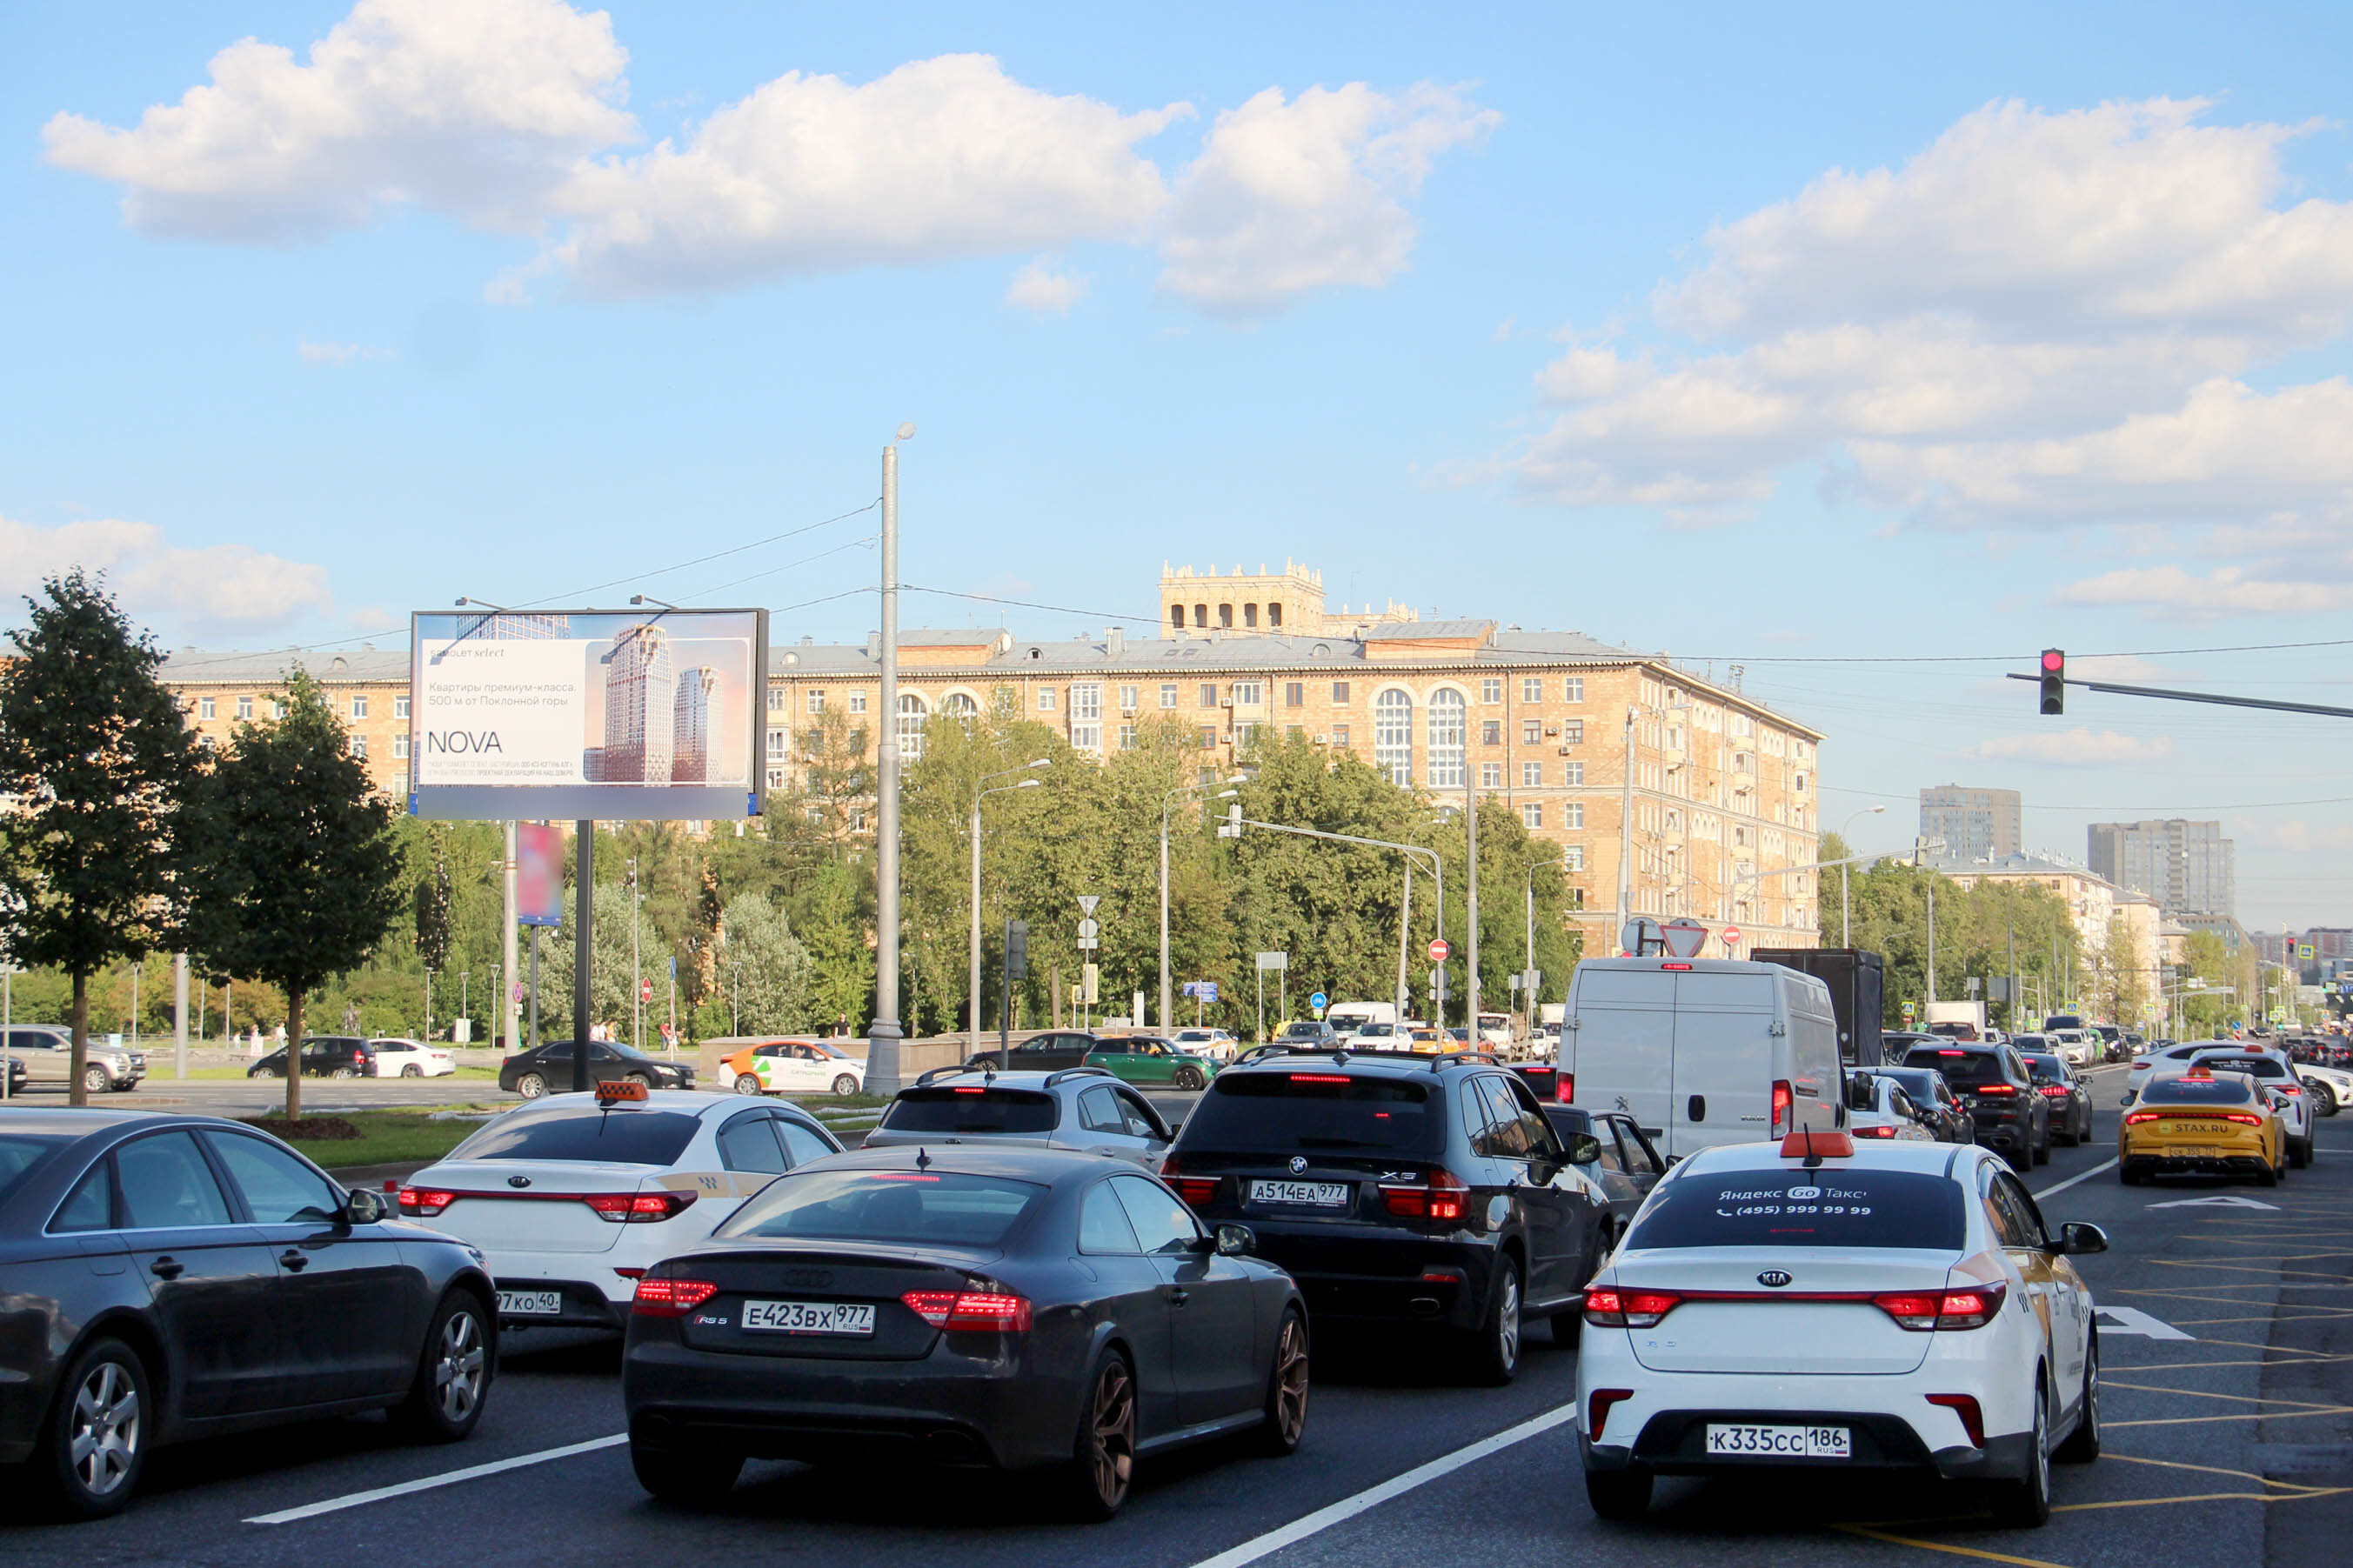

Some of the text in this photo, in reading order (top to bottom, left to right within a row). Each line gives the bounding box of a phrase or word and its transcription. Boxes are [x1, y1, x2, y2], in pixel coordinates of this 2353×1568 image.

[476, 648, 505, 657] select
[429, 683, 482, 695] Квартиры
[429, 696, 451, 705] 500
[480, 696, 539, 705] Поклонной
[542, 698, 568, 707] горы
[428, 731, 503, 753] NOVA
[2176, 1124, 2228, 1133] STAX.RU
[1380, 1171, 1417, 1180] X5
[1255, 1183, 1343, 1200] А514ЕА 977
[1719, 1190, 1782, 1201] Яндекс
[1826, 1188, 1867, 1198] Такс
[1736, 1206, 1780, 1216] (495)
[1762, 1273, 1786, 1284] KIA
[539, 1293, 555, 1306] 40
[749, 1304, 870, 1328] Е423ВХ 977
[1715, 1428, 1842, 1451] К335СС 186
